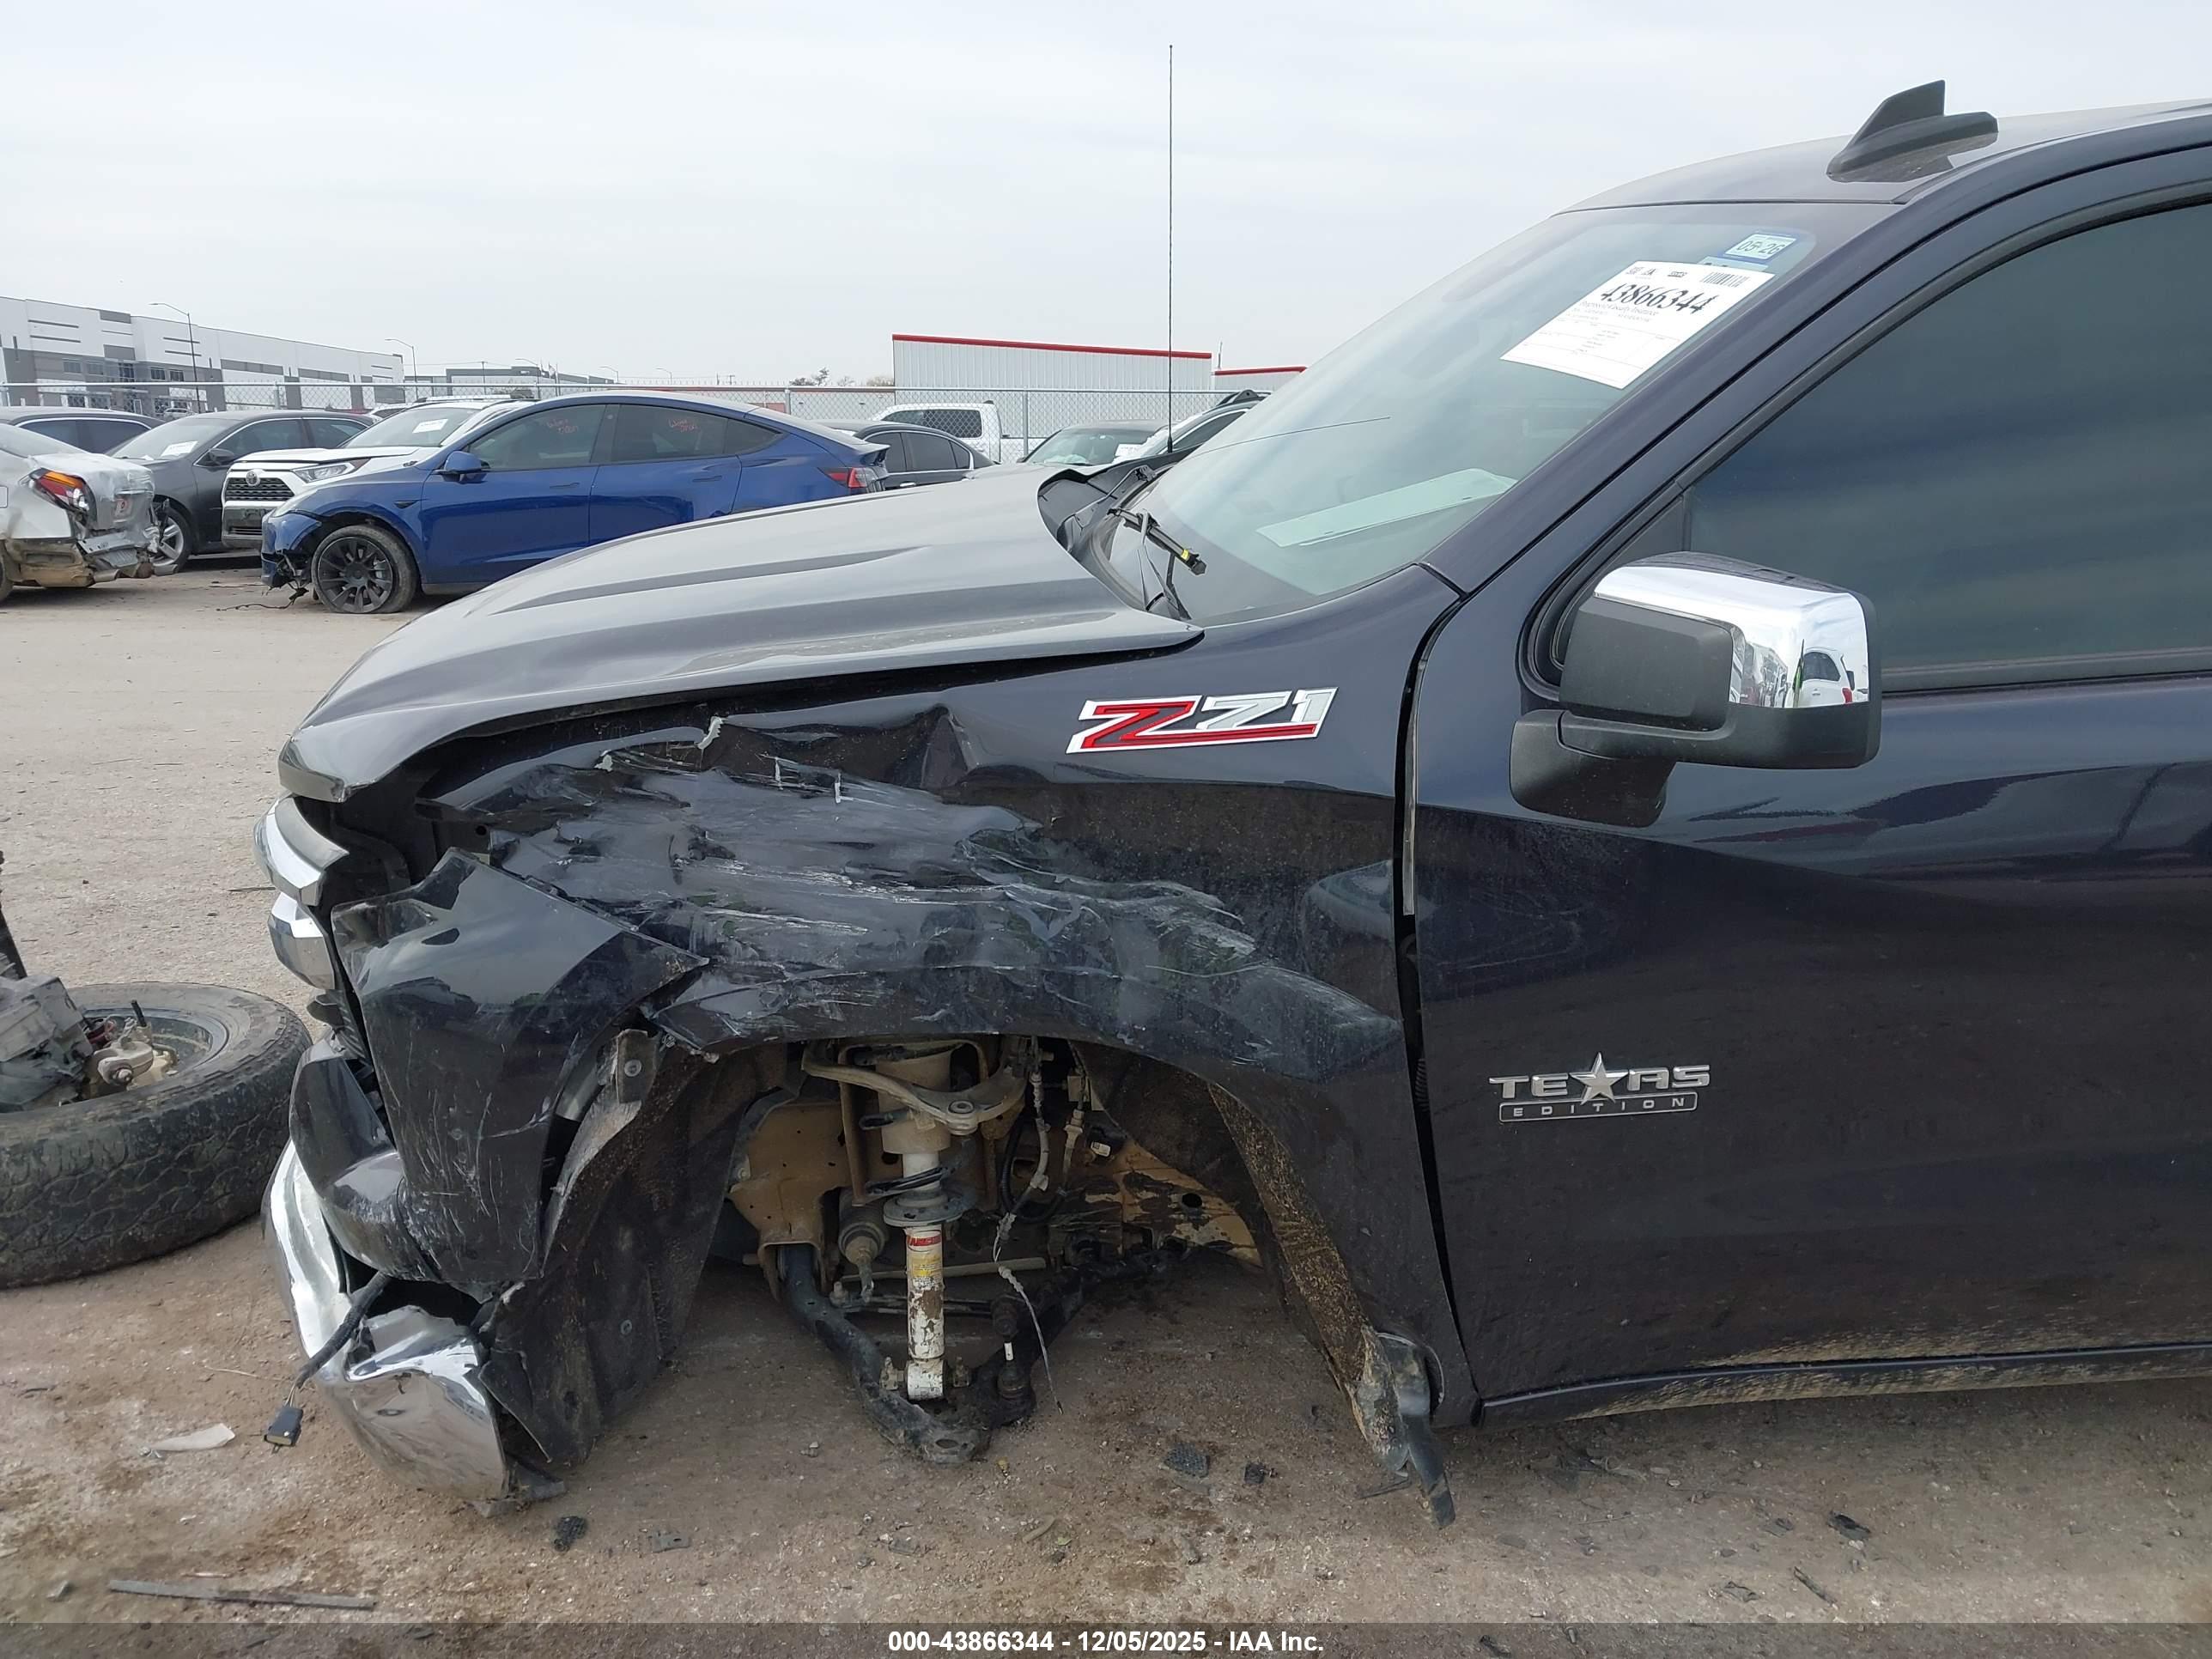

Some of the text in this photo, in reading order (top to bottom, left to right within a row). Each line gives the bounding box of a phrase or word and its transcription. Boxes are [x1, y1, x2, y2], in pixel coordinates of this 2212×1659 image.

[1600, 283, 1720, 315] 43866344
[1066, 687, 1339, 754] Z71
[1513, 1097, 1685, 1117] EDITION
